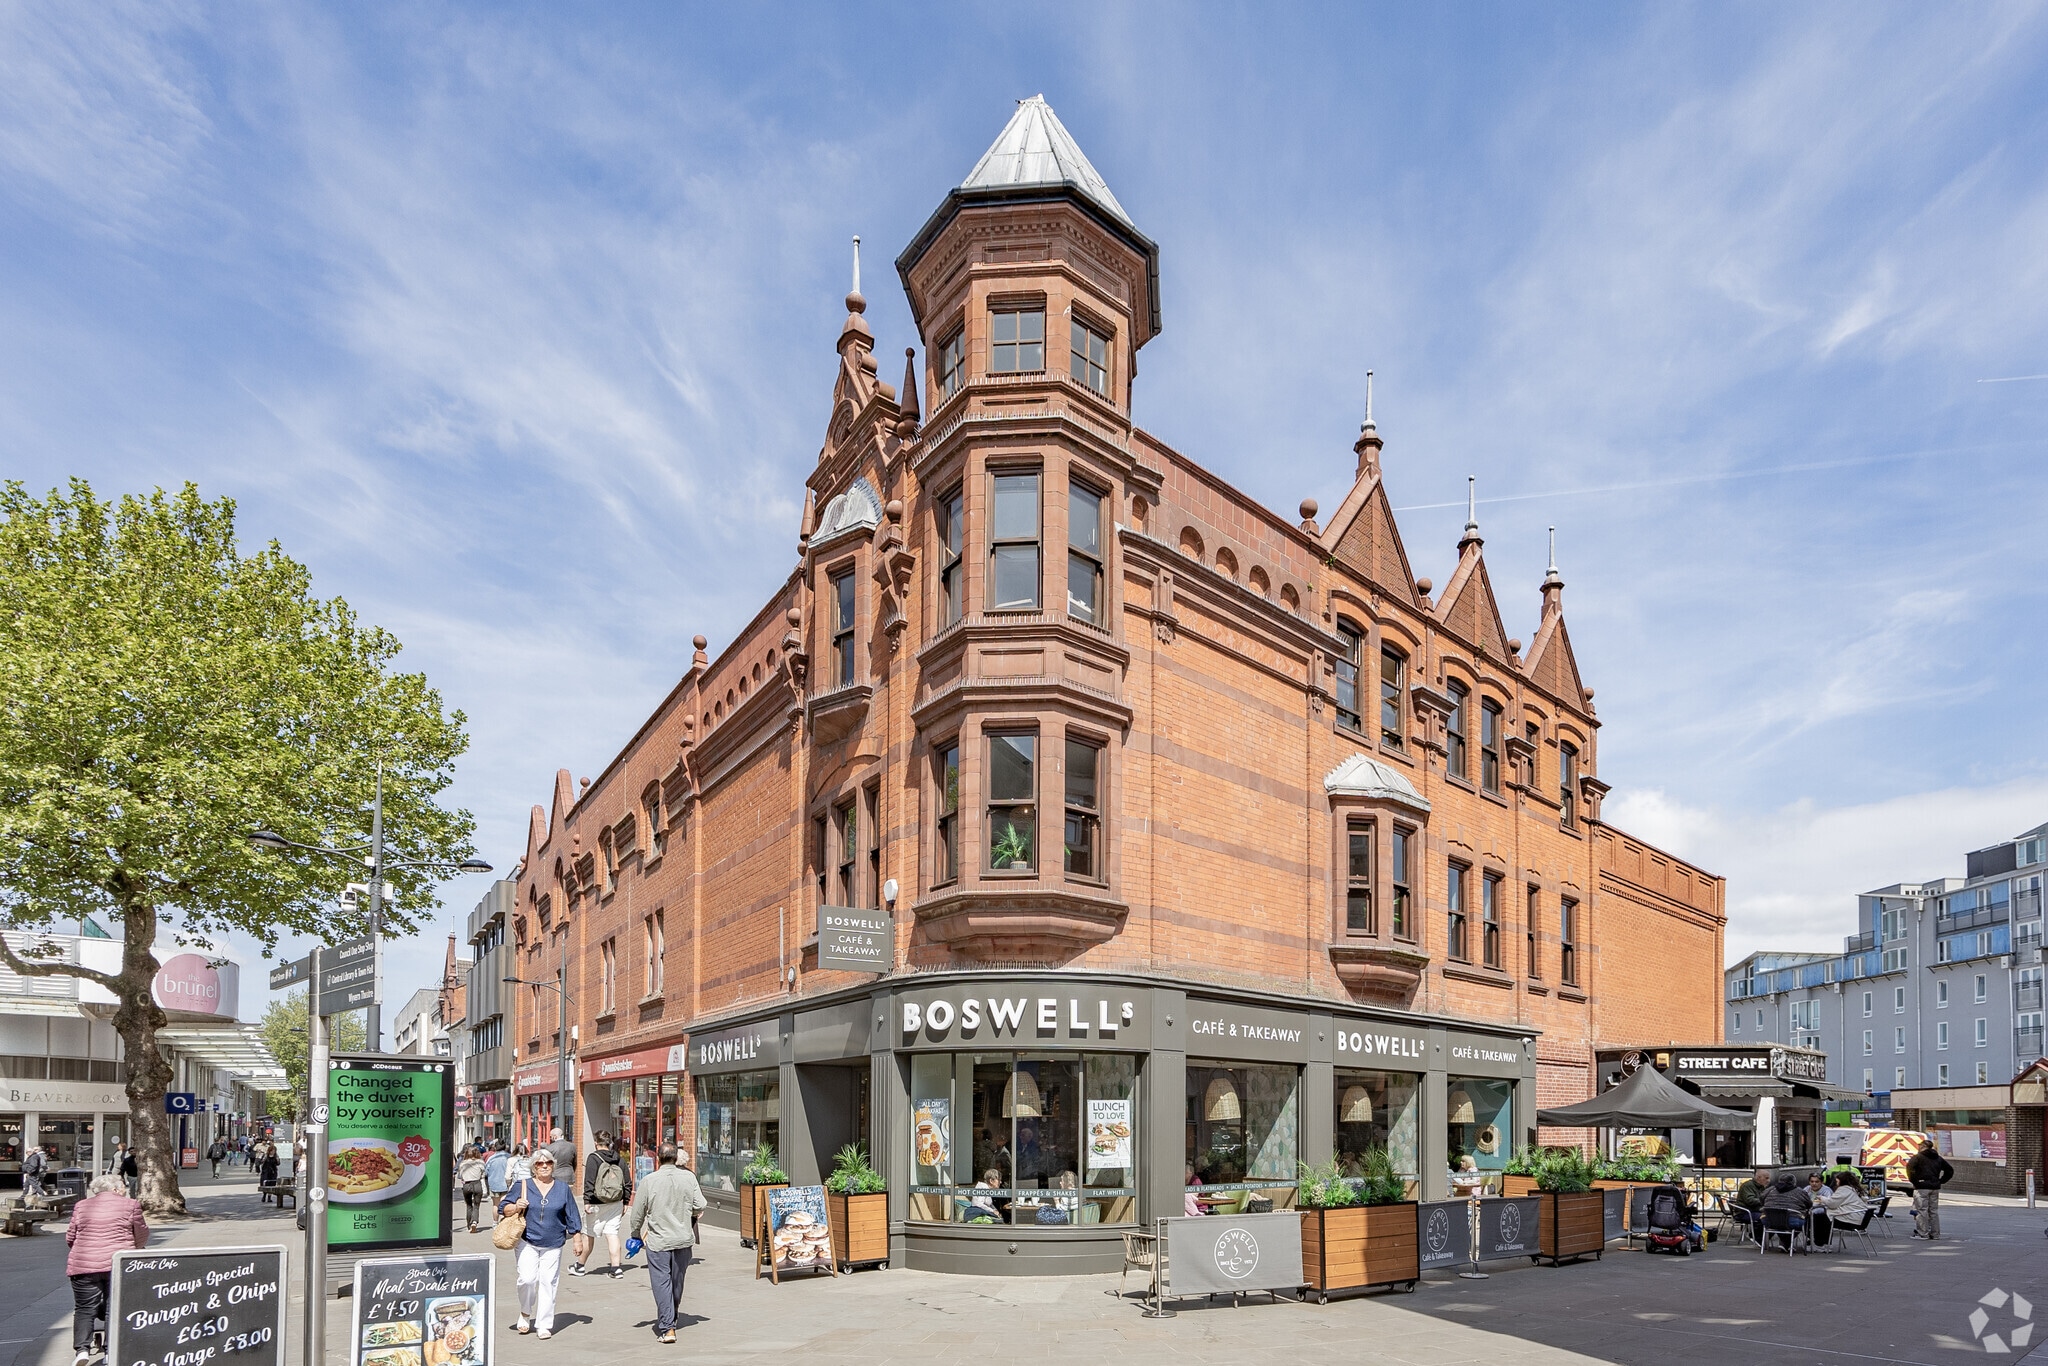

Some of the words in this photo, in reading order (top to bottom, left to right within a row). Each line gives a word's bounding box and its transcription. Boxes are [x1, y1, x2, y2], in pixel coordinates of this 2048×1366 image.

[826, 916, 885, 930] BOSWELLS
[838, 934, 863, 945] CAFÉ
[866, 937, 873, 945] &
[829, 944, 881, 956] TAKEAWAY
[188, 973, 200, 982] the
[331, 972, 343, 984] Central
[342, 970, 355, 981] Library
[366, 964, 374, 974] Hall
[164, 973, 218, 999] brunel
[903, 998, 1134, 1032] BOSWELLS
[1192, 1018, 1225, 1036] CAFÉ
[1229, 1023, 1238, 1037] &
[1241, 1024, 1301, 1043] TAKEAWAY
[700, 1034, 761, 1065] BOSWELLS
[1337, 1030, 1425, 1058] BOSWELLS
[1452, 1045, 1472, 1059] CAFÉ
[1473, 1049, 1480, 1059] &
[1480, 1049, 1517, 1063] TAKEAWAY
[1678, 1057, 1730, 1069] STREET
[1731, 1057, 1768, 1069] CAFE
[337, 1074, 412, 1091] Changed
[172, 1096, 190, 1111] O2
[337, 1091, 364, 1103] the
[368, 1091, 415, 1103] duvet
[337, 1106, 358, 1121] by
[362, 1106, 435, 1121] yourself?
[1092, 1102, 1125, 1111] LUNCH
[1093, 1112, 1105, 1120] TO
[1106, 1112, 1125, 1120] LOVE
[3, 1124, 21, 1132] TA
[404, 1142, 427, 1153] 30%
[780, 1189, 812, 1197] BOSWELLS
[930, 1187, 944, 1195] LATTE
[1018, 1188, 1045, 1196] FRAPPÉS
[772, 1196, 806, 1204] BREAKFAST
[353, 1213, 377, 1222] Uber
[353, 1222, 377, 1230] Eats
[1217, 1231, 1256, 1257] BOSWELLS
[1507, 1243, 1525, 1251] Takeaway
[1435, 1251, 1454, 1260] Takeaway
[125, 1260, 157, 1273] Street
[158, 1258, 179, 1270] Cafe
[152, 1278, 202, 1299] Todays
[206, 1262, 255, 1287] Special
[405, 1268, 431, 1281] Street
[431, 1266, 448, 1277] Cafe
[372, 1278, 405, 1300] Meal
[408, 1278, 450, 1294] Deals
[450, 1277, 478, 1293] from
[126, 1301, 199, 1330] Burger
[206, 1293, 222, 1310] &
[227, 1281, 277, 1305] Chips
[367, 1303, 381, 1320] £
[386, 1299, 420, 1321] 4.50
[177, 1315, 229, 1345] £6.50
[223, 1327, 272, 1354] £8.00
